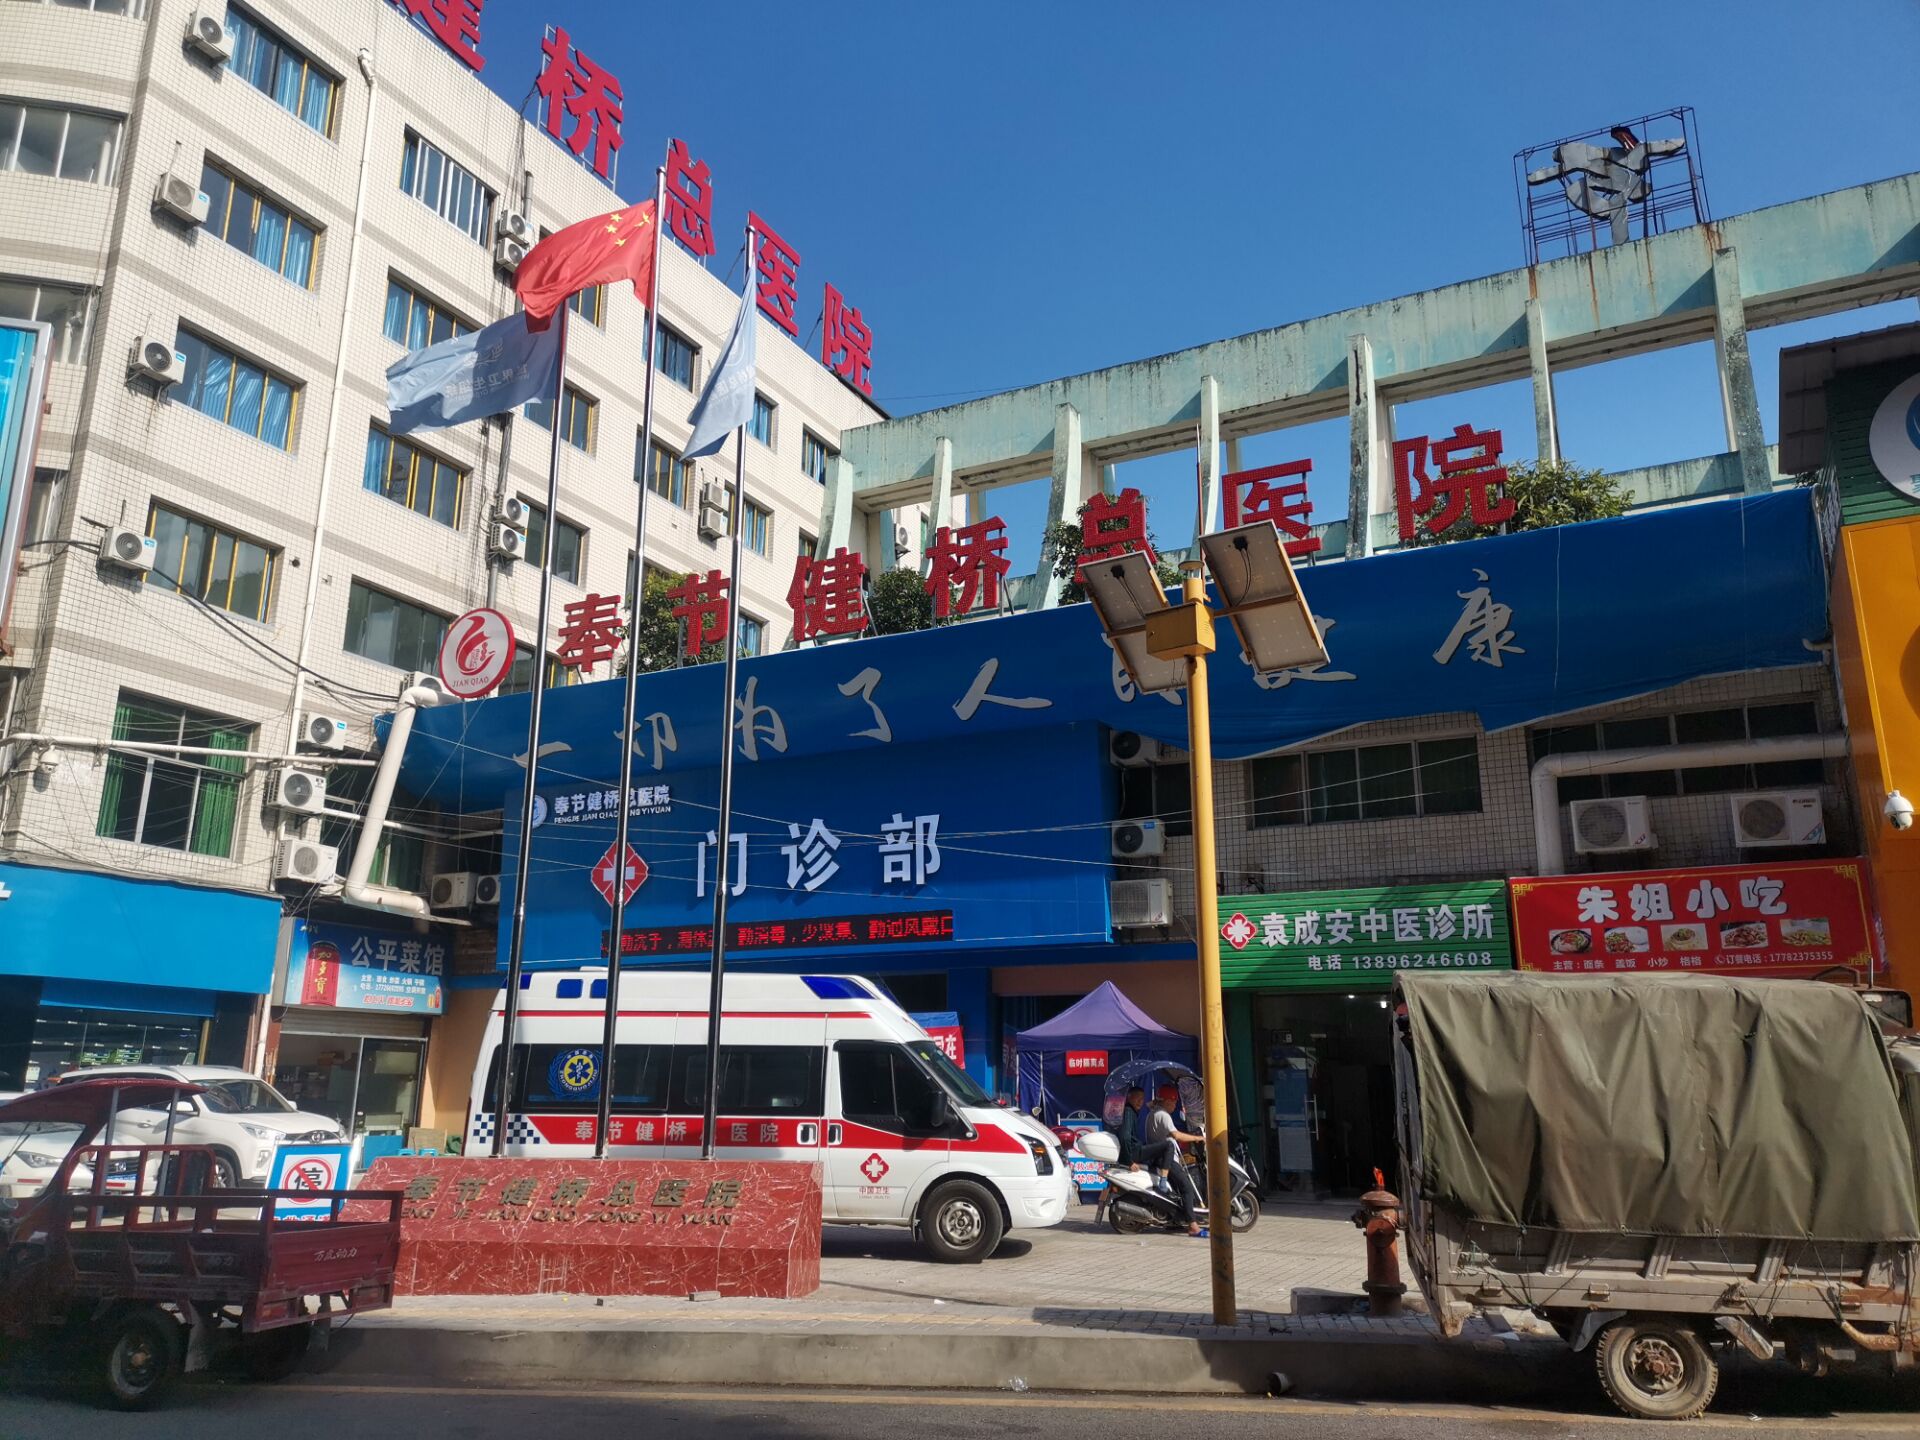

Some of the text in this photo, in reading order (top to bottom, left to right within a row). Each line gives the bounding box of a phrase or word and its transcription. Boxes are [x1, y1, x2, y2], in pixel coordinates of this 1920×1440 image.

[697, 813, 941, 897] 门诊部
[1577, 876, 1787, 923] 朱姐小吃
[1260, 903, 1494, 948] 袁成安中医诊所
[351, 936, 445, 976] 公平菜馆
[1308, 952, 1492, 971] 电话 13896246608
[1648, 957, 1669, 968] 小炒
[575, 1121, 779, 1144] 奉节健桥医院
[403, 1175, 743, 1208] 奉节健桥总医院
[587, 1211, 641, 1223] ZONG
[680, 1213, 733, 1226] YUAN
